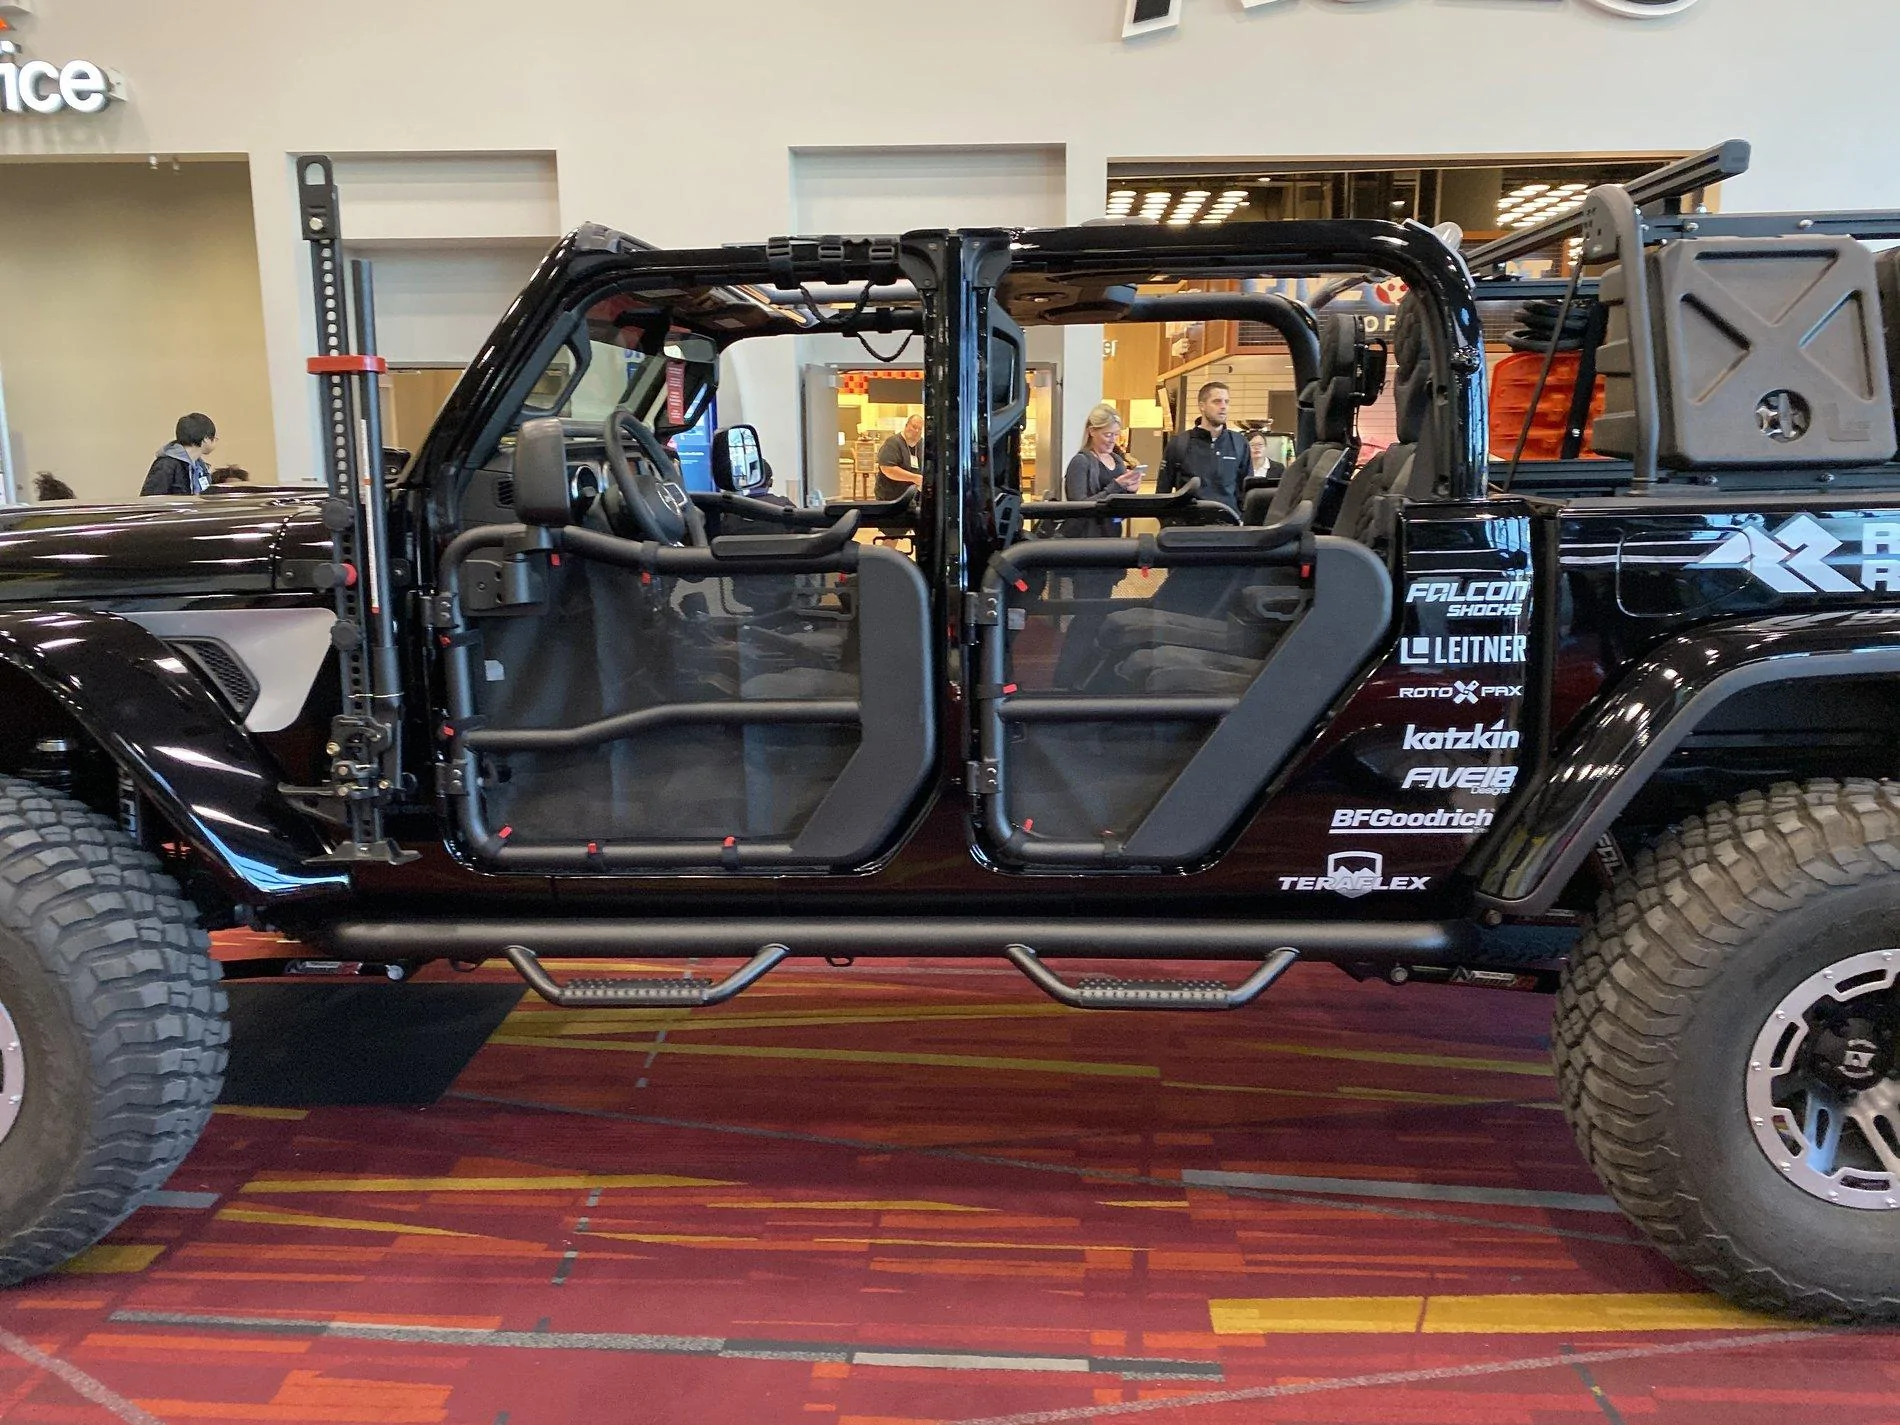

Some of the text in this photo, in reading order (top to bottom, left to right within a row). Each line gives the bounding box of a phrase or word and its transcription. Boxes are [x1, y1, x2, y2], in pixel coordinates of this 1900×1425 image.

[1405, 580, 1529, 602] FALCON
[1446, 603, 1523, 616] SHOCKS
[1434, 635, 1527, 663] LEITNER
[1402, 719, 1520, 750] katzkin
[1330, 808, 1493, 827] BFGoodrich
[1278, 876, 1432, 891] TERAFLEX
